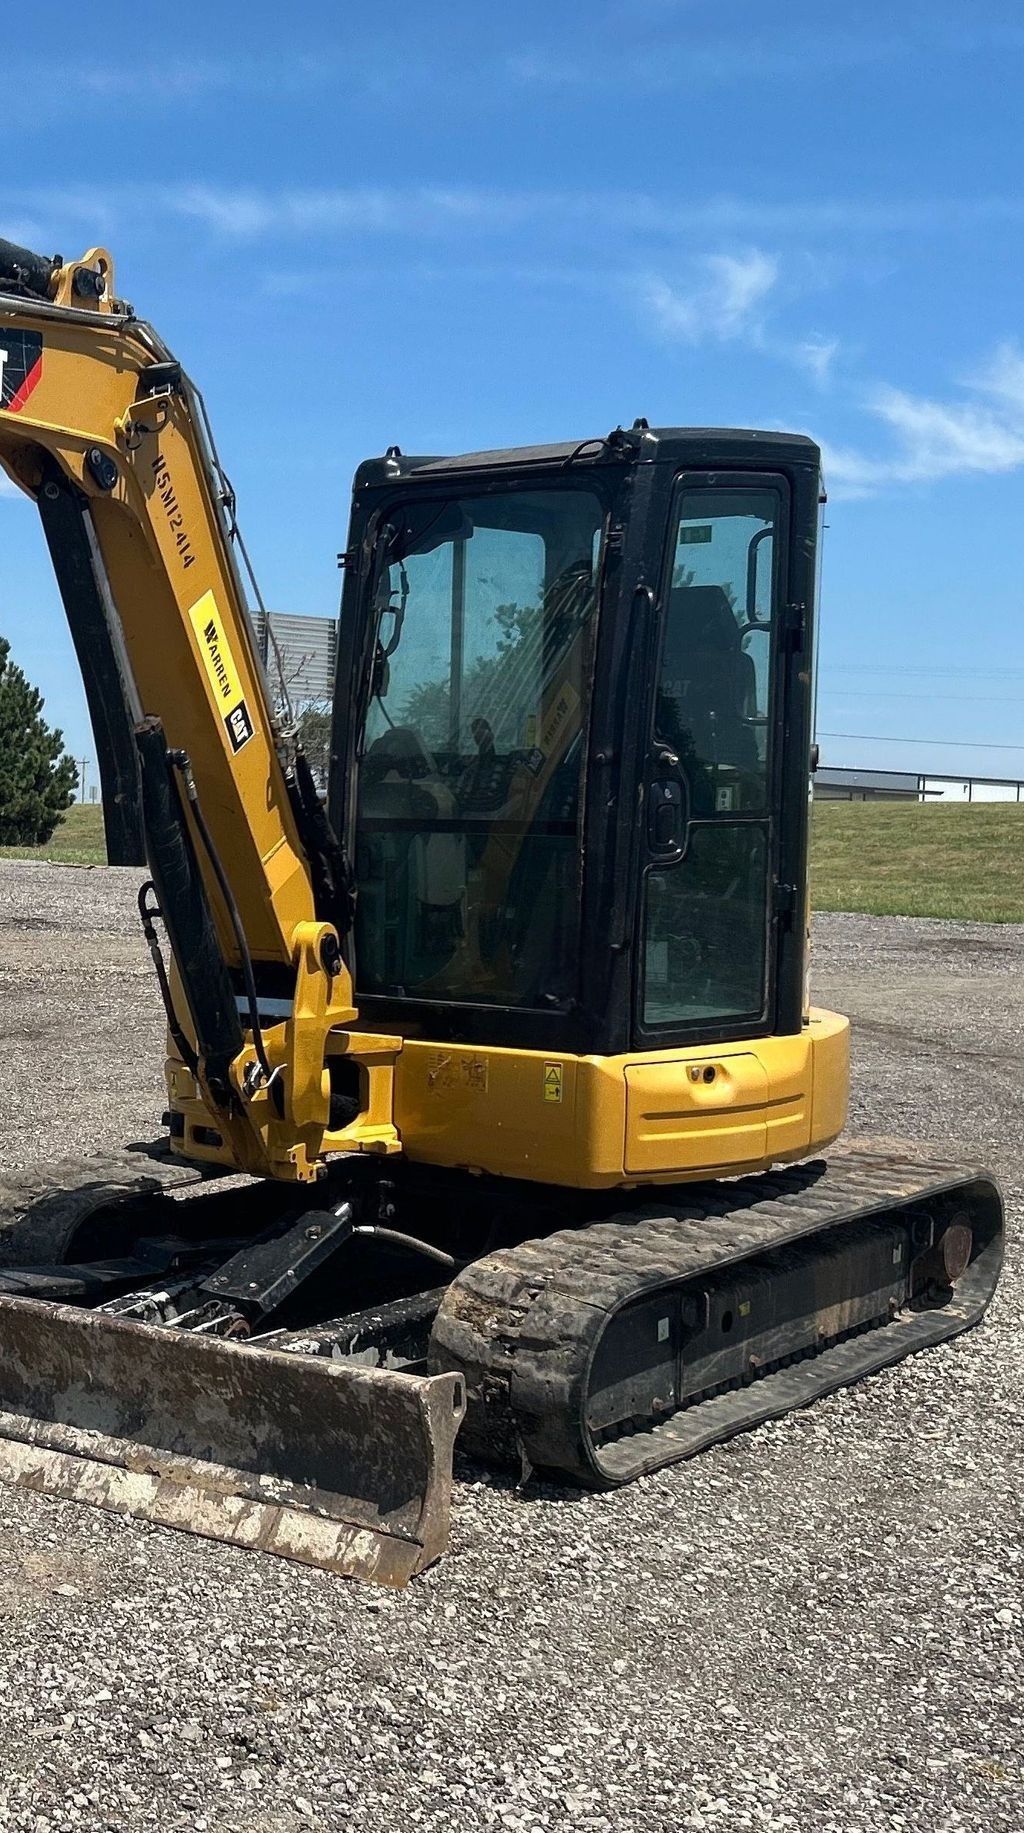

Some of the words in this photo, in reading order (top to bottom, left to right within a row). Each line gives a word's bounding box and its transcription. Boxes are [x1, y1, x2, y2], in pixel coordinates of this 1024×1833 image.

[151, 454, 196, 570] H5M12414
[203, 618, 232, 698] WARREN
[229, 708, 249, 744] CAT
